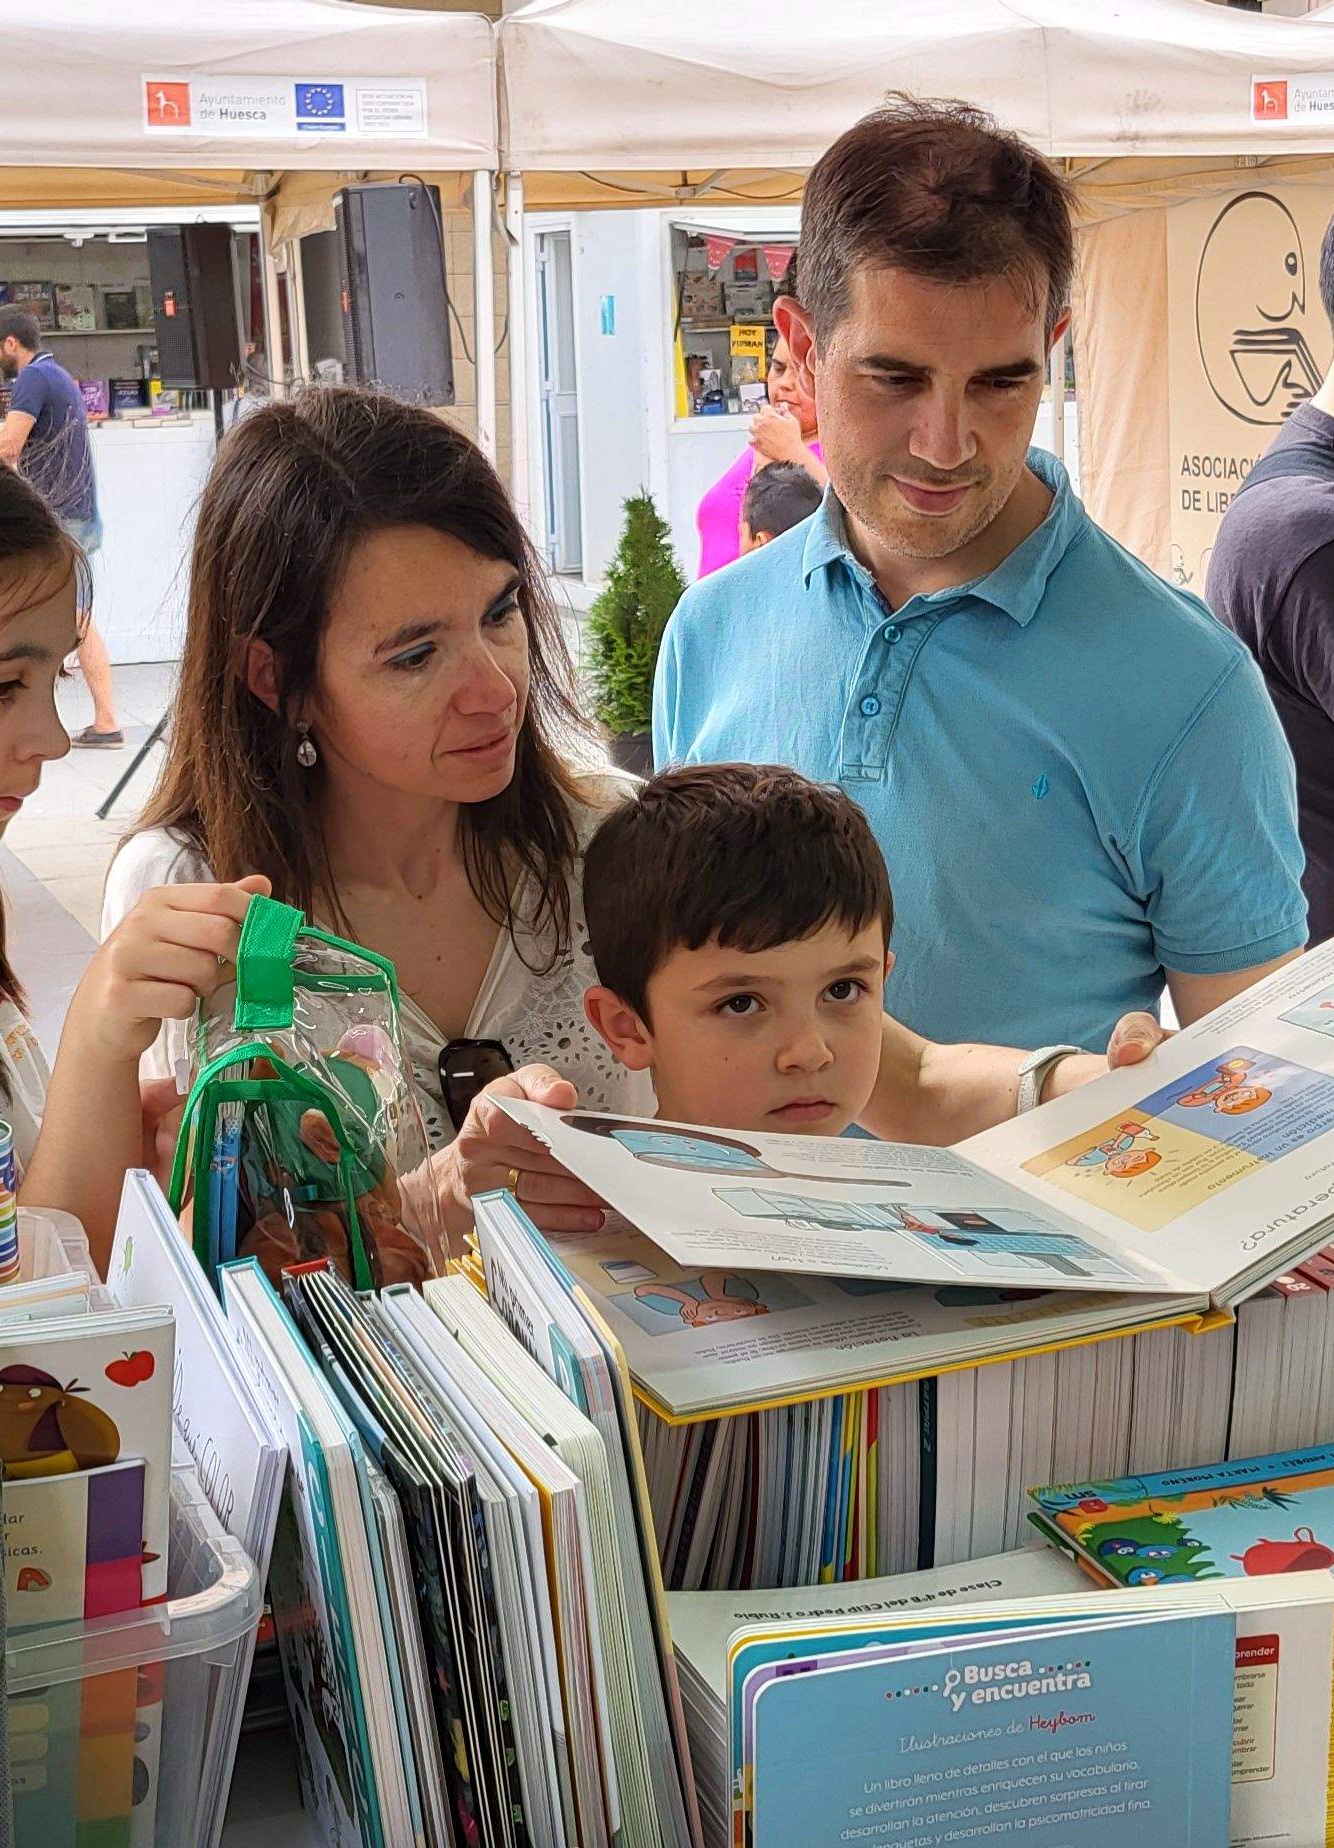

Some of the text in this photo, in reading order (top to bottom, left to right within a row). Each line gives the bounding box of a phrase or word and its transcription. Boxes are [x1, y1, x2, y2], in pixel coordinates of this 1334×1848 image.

[199, 93, 286, 108] Ayuntamiento
[1294, 102, 1306, 112] de
[200, 108, 267, 120] de Huesca
[1182, 489, 1201, 512] DE
[1161, 1472, 1214, 1487] MORENO
[1216, 1465, 1262, 1480] MARTA
[937, 1587, 957, 1598] de
[959, 1579, 1003, 1593] Clase
[885, 1597, 909, 1609] del
[795, 1607, 845, 1618] Pedro
[965, 1660, 1033, 1685] Busca
[950, 1670, 1093, 1712] y encuentra
[898, 1720, 1025, 1754] Ilustraciones de
[864, 1740, 1128, 1794] Un libro lleno de detalles con el que los niños
[849, 1805, 864, 1818] se
[865, 1794, 923, 1815] divertirán
[926, 1787, 978, 1806] mientras
[980, 1774, 1047, 1796] enriquecen
[1050, 1771, 1064, 1783] su
[840, 1818, 910, 1841] desarrollan
[912, 1814, 924, 1828] la
[984, 1794, 1047, 1814] descubren
[1050, 1785, 1107, 1806] sorpresas
[1110, 1782, 1122, 1795] al
[1124, 1778, 1150, 1792] tirar
[944, 1819, 1012, 1843] desarrollan
[1014, 1816, 1027, 1830] la
[1028, 1801, 1126, 1829] psicomotricidad
